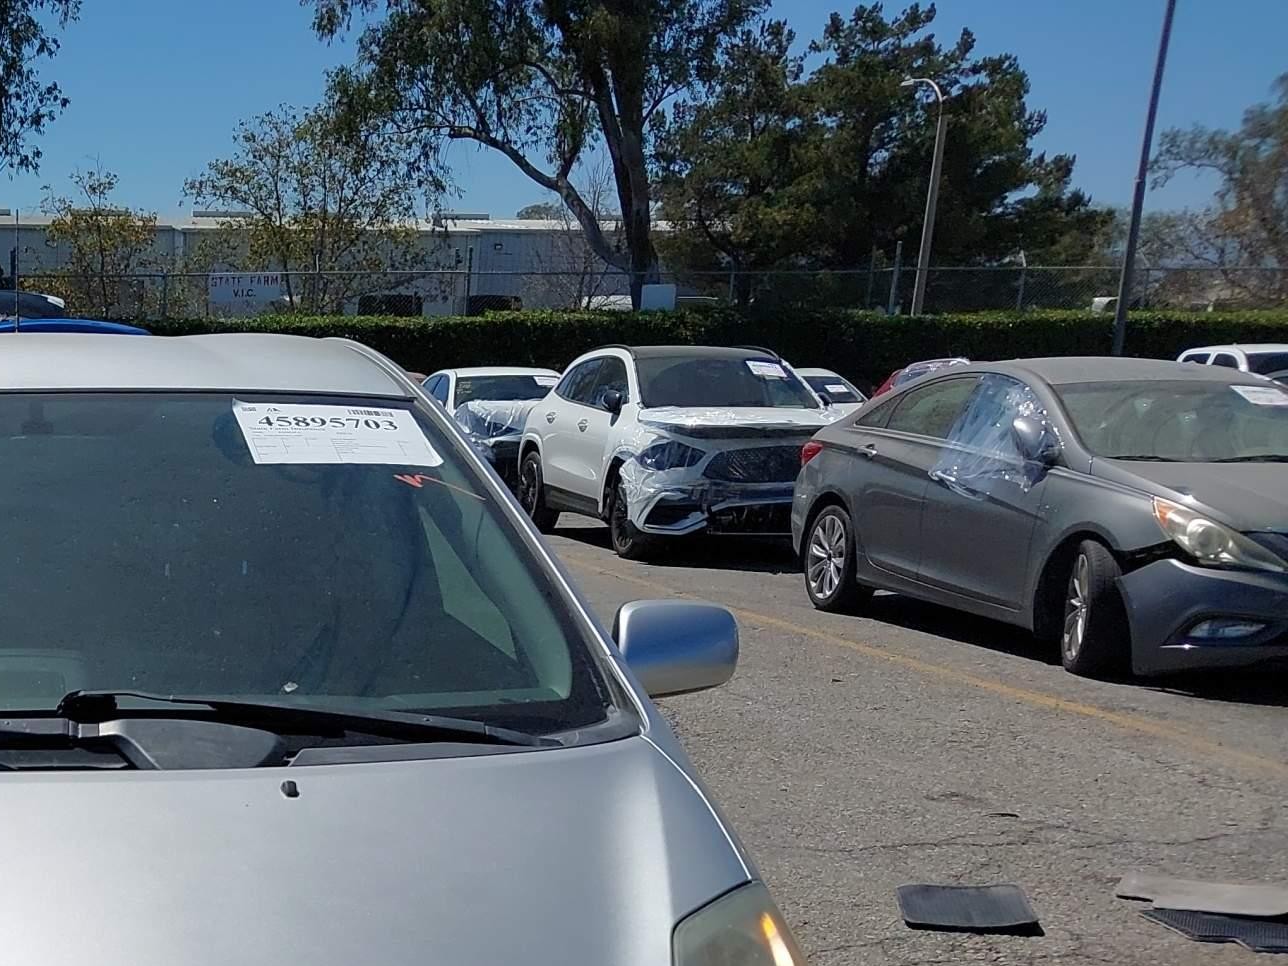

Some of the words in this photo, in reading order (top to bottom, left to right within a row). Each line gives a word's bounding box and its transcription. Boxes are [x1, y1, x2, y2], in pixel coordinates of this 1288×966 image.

[211, 276, 242, 287] STATE
[250, 275, 279, 287] FARM
[232, 288, 256, 298] V.I.C.
[258, 416, 398, 431] 45895703
